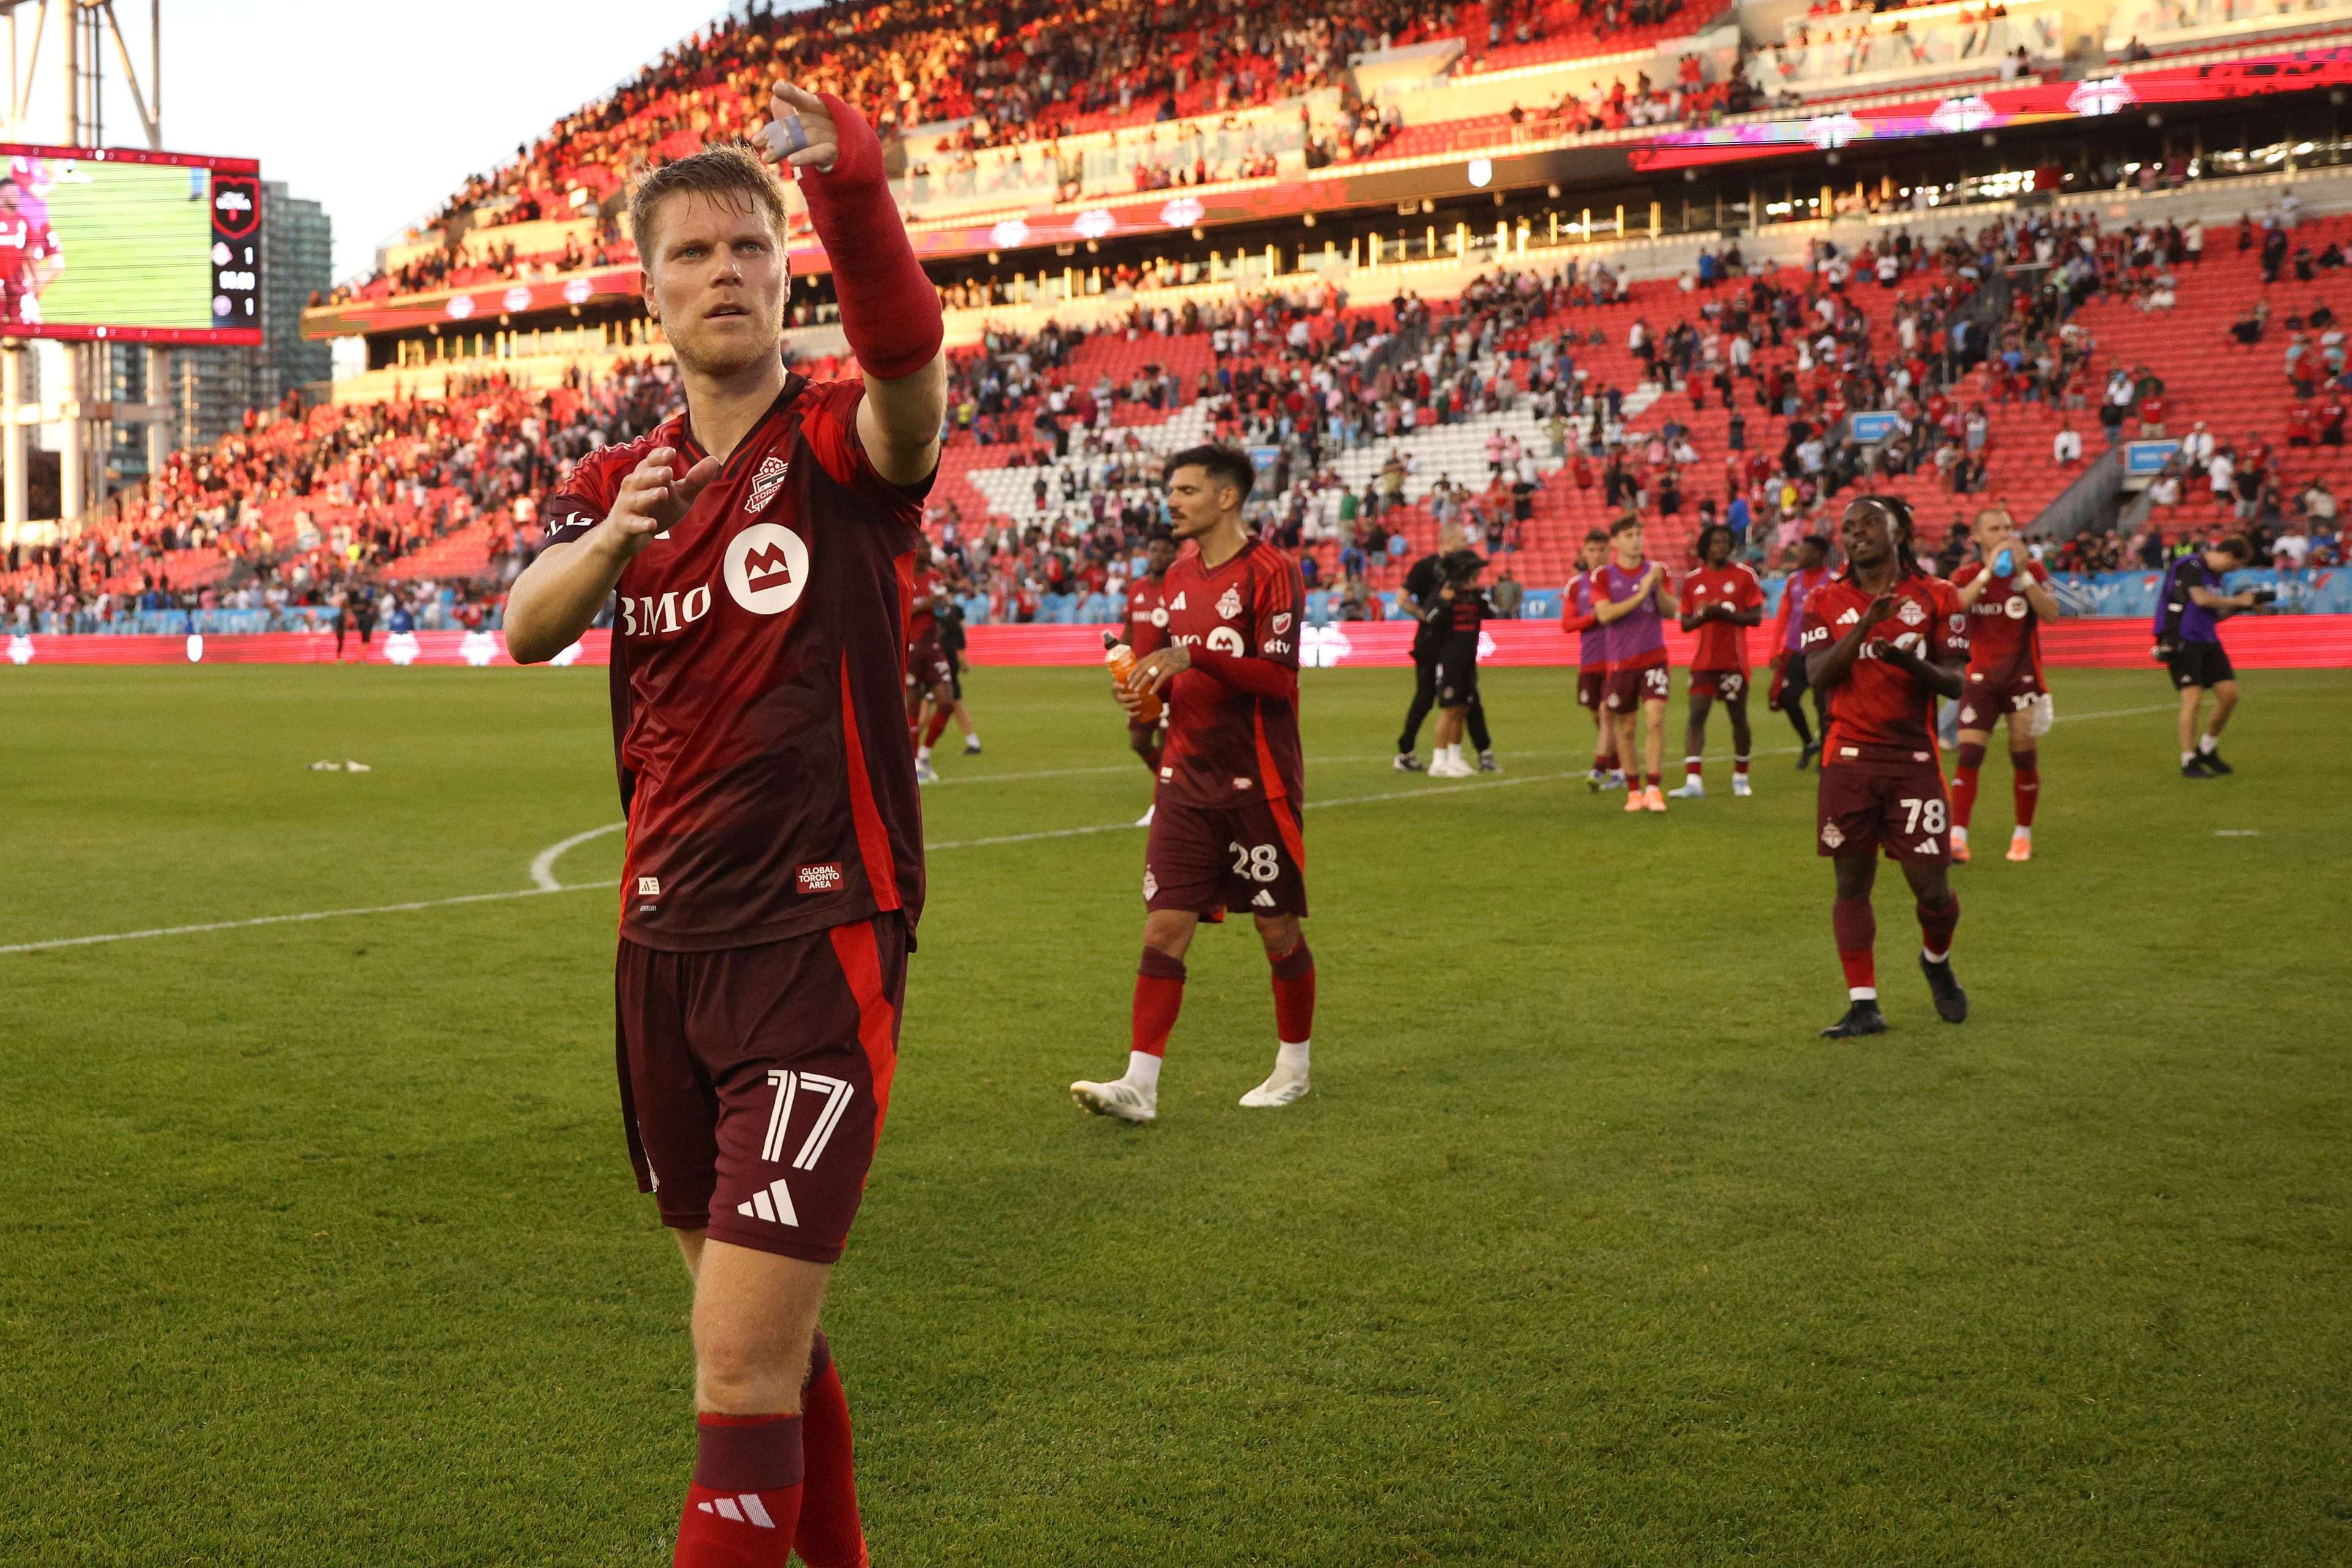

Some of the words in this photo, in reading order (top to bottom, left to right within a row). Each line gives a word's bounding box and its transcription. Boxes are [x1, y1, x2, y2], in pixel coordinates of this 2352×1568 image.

[1900, 798, 1947, 834] 78
[801, 865, 835, 875] GLOBAL
[1229, 841, 1280, 882] 28
[798, 872, 840, 883] TORONTO
[809, 880, 831, 889] AREA
[761, 1069, 854, 1171] 17
